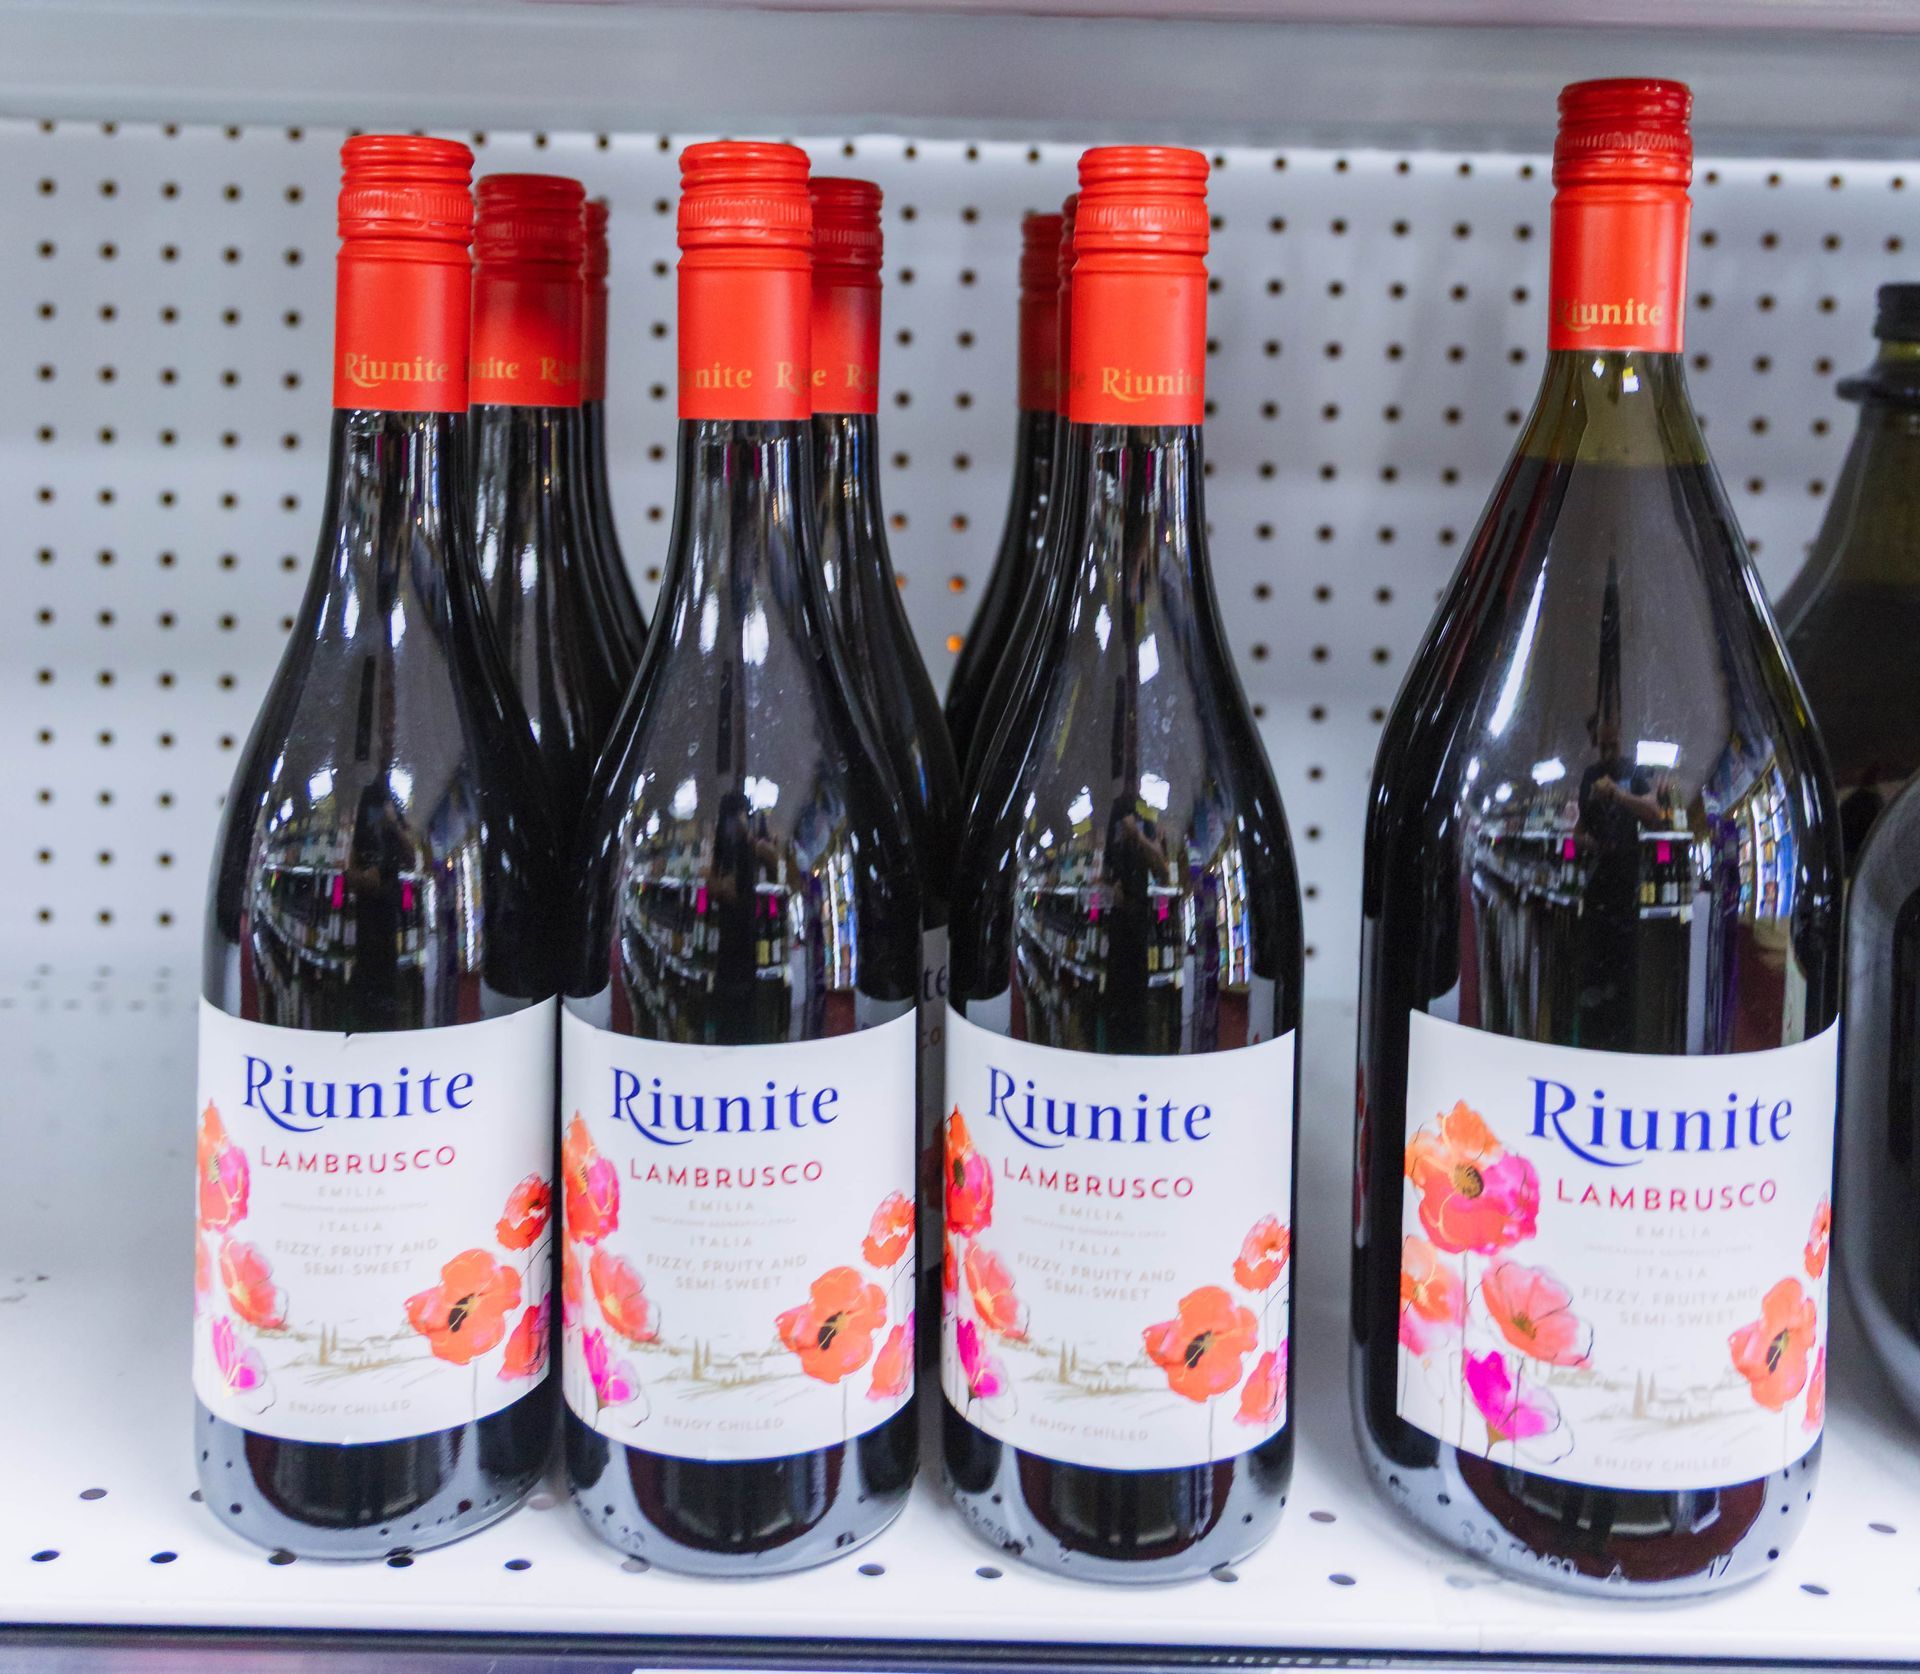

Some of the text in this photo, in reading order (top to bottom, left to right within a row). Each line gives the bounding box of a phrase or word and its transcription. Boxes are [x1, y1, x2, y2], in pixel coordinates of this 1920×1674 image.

[344, 353, 449, 389] Riunite
[242, 1053, 474, 1132] Riunite
[610, 1066, 839, 1146] Riunite
[985, 1065, 1212, 1149] Riunite
[1526, 1076, 1793, 1168] Riunite
[261, 1145, 456, 1174] LAMBRUSCO
[630, 1158, 823, 1189] LAMBRUSCO
[1003, 1157, 1194, 1200] LAMBRUSCO
[318, 1185, 385, 1197] EMILIA
[1557, 1178, 1777, 1212] LAMBRUSCO
[688, 1200, 754, 1212] EMILIA
[1058, 1203, 1124, 1221] EMILIA
[319, 1221, 383, 1232] ITALIA
[1635, 1225, 1712, 1239] EMILIA
[332, 1243, 393, 1257] FRUITY
[400, 1238, 439, 1254] AND
[689, 1235, 753, 1248] ITALIA
[1059, 1239, 1122, 1257] ITALIA
[703, 1259, 764, 1272] FRUITY
[771, 1254, 808, 1269] AND
[1636, 1265, 1708, 1280] ITALIA
[1071, 1264, 1132, 1283] FRUITY
[1138, 1269, 1176, 1282] AND
[1652, 1291, 1721, 1306] FRUITY
[1726, 1287, 1758, 1302] AND
